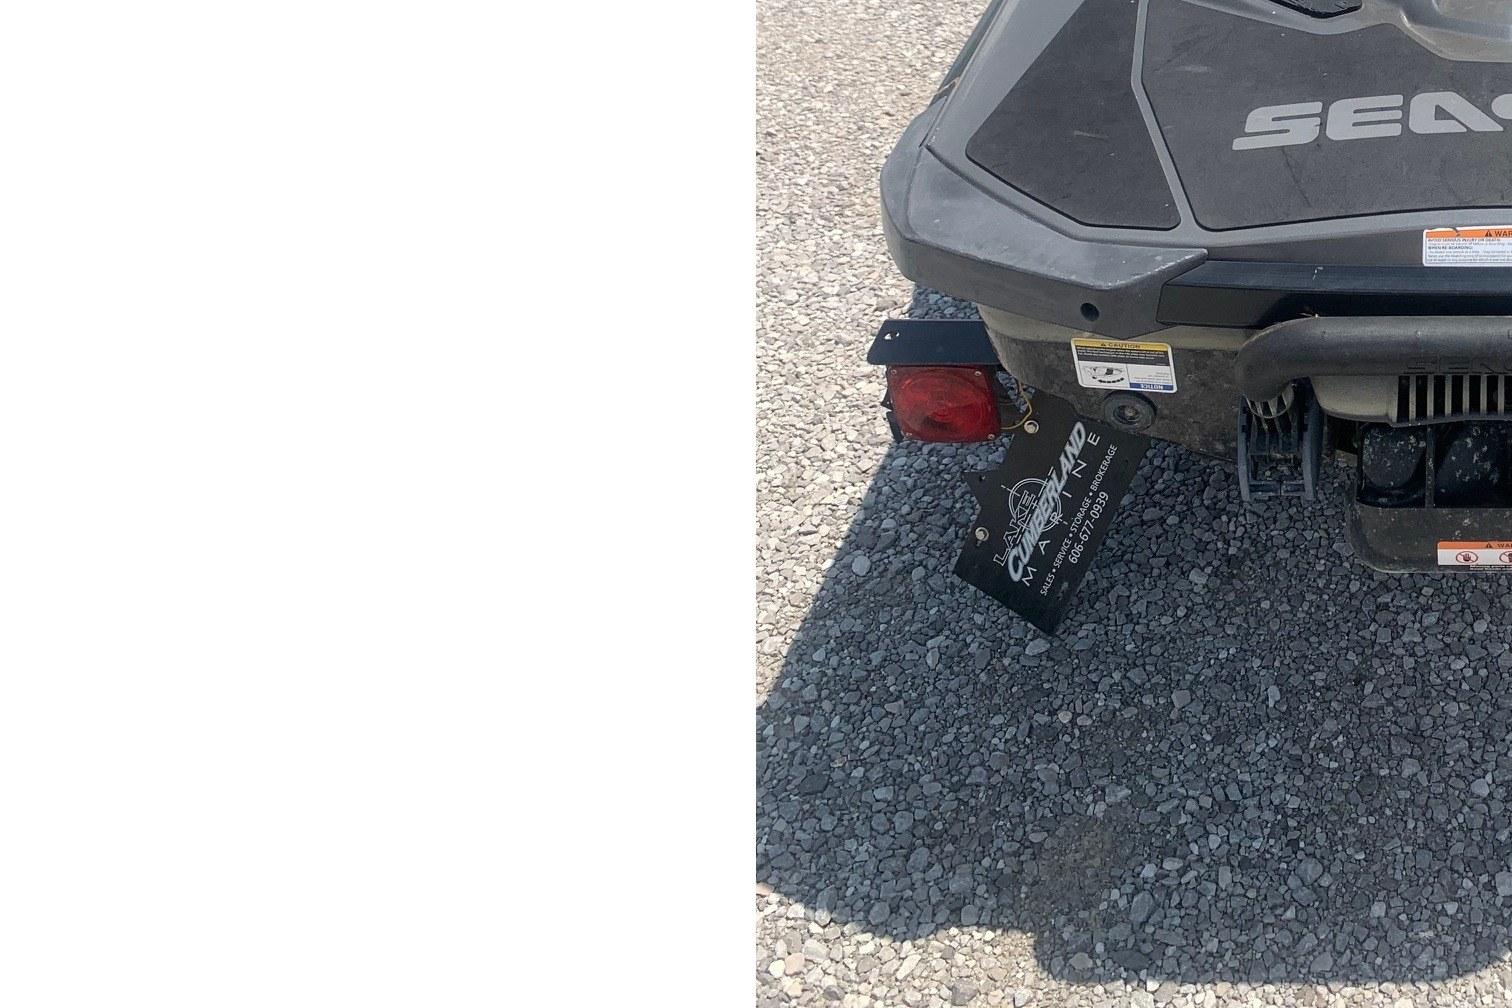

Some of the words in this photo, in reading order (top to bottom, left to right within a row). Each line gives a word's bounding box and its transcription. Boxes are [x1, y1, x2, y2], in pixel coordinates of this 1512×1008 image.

[993, 490, 1037, 567] LAKE
[1007, 421, 1086, 582] CUMBERLAND
[1040, 573, 1056, 596] SALES
[1053, 537, 1074, 569] SERVICE
[1071, 496, 1093, 534] STORAGE
[1089, 443, 1118, 492] BROKERAGE
[1068, 491, 1110, 565] 606-677-0939
